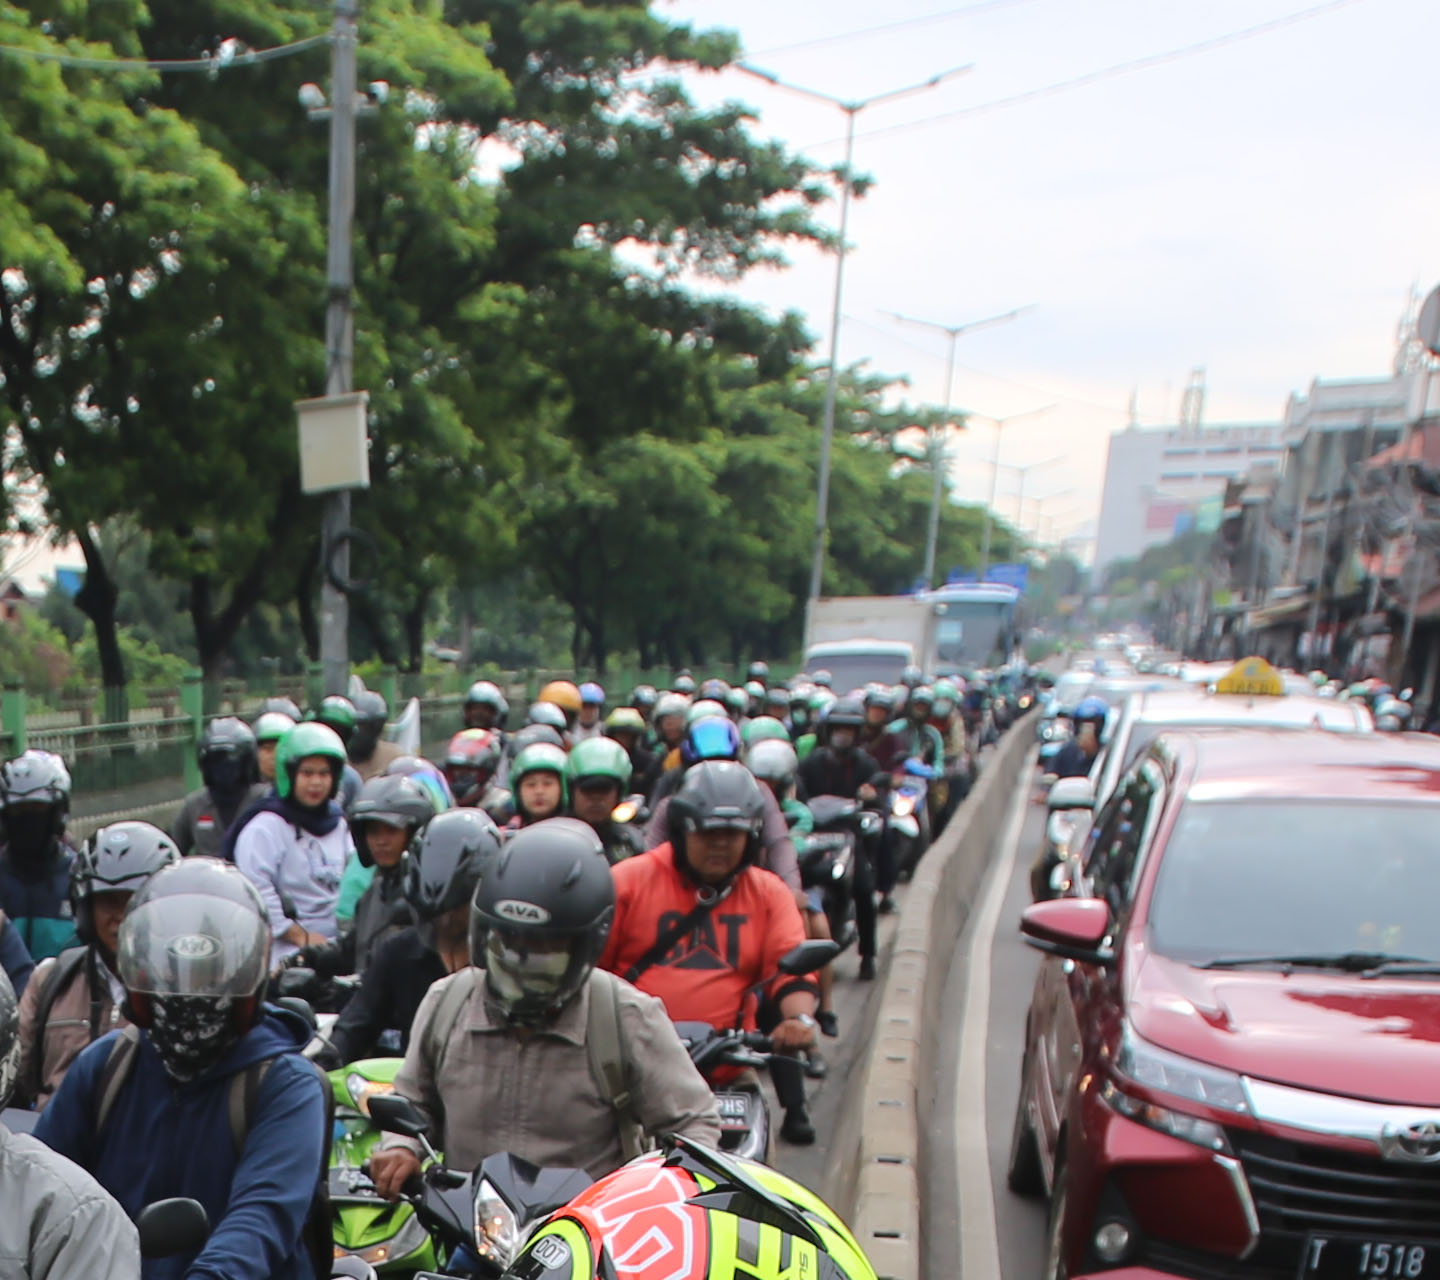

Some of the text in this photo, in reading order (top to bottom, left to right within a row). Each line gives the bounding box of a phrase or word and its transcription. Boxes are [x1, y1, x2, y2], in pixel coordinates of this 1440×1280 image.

[503, 903, 540, 920] AVA
[535, 1238, 564, 1266] DOT
[1311, 1239, 1328, 1270] T
[1359, 1242, 1425, 1278] 1518
